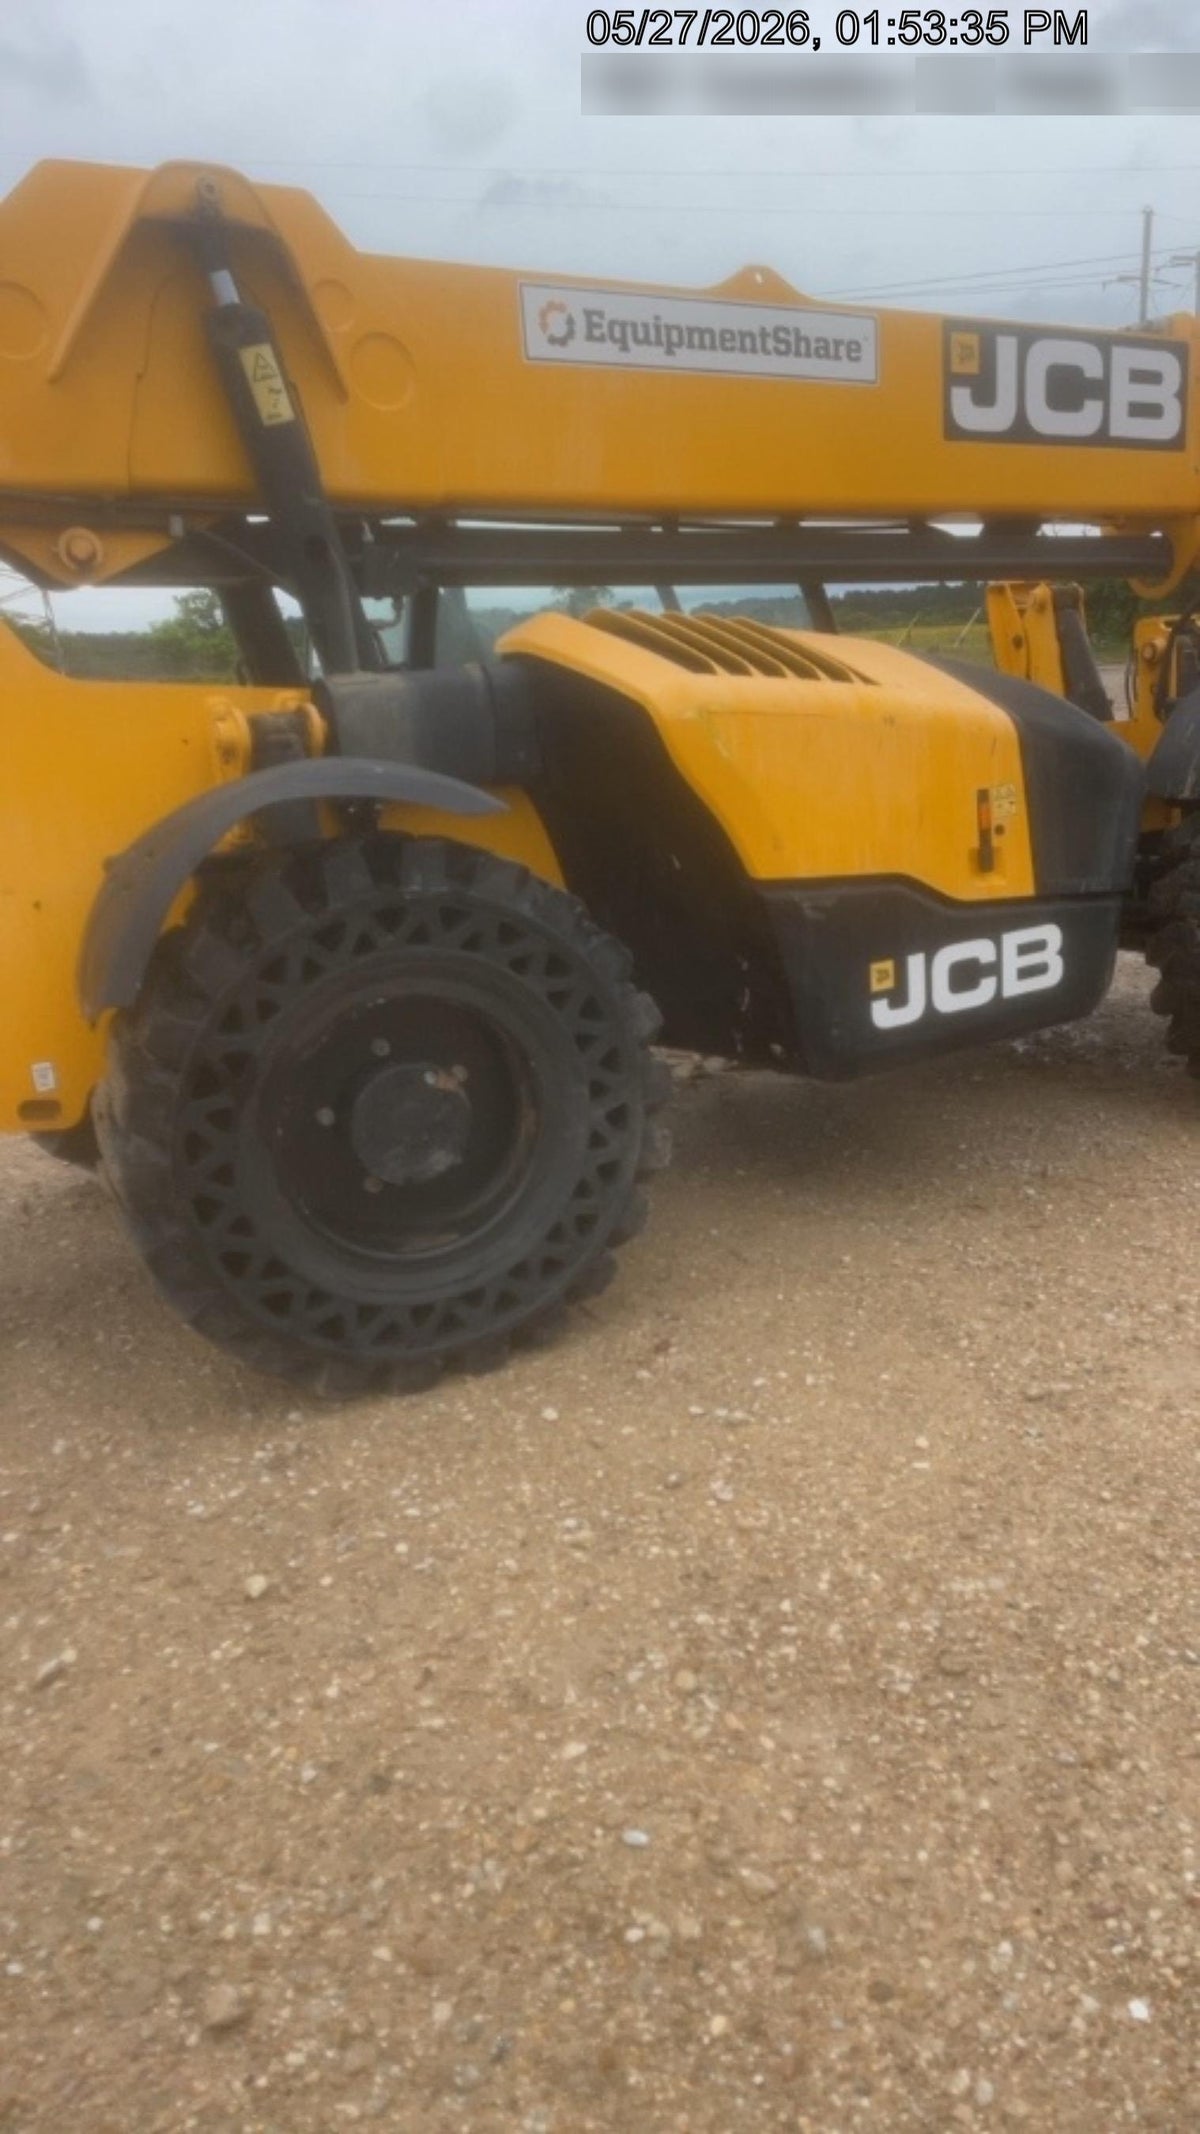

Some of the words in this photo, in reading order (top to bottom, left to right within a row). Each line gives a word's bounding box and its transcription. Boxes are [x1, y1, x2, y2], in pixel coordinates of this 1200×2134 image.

[582, 307, 863, 364] EquipmentShare
[950, 335, 1183, 441] JCB
[871, 922, 1064, 1030] JCB
